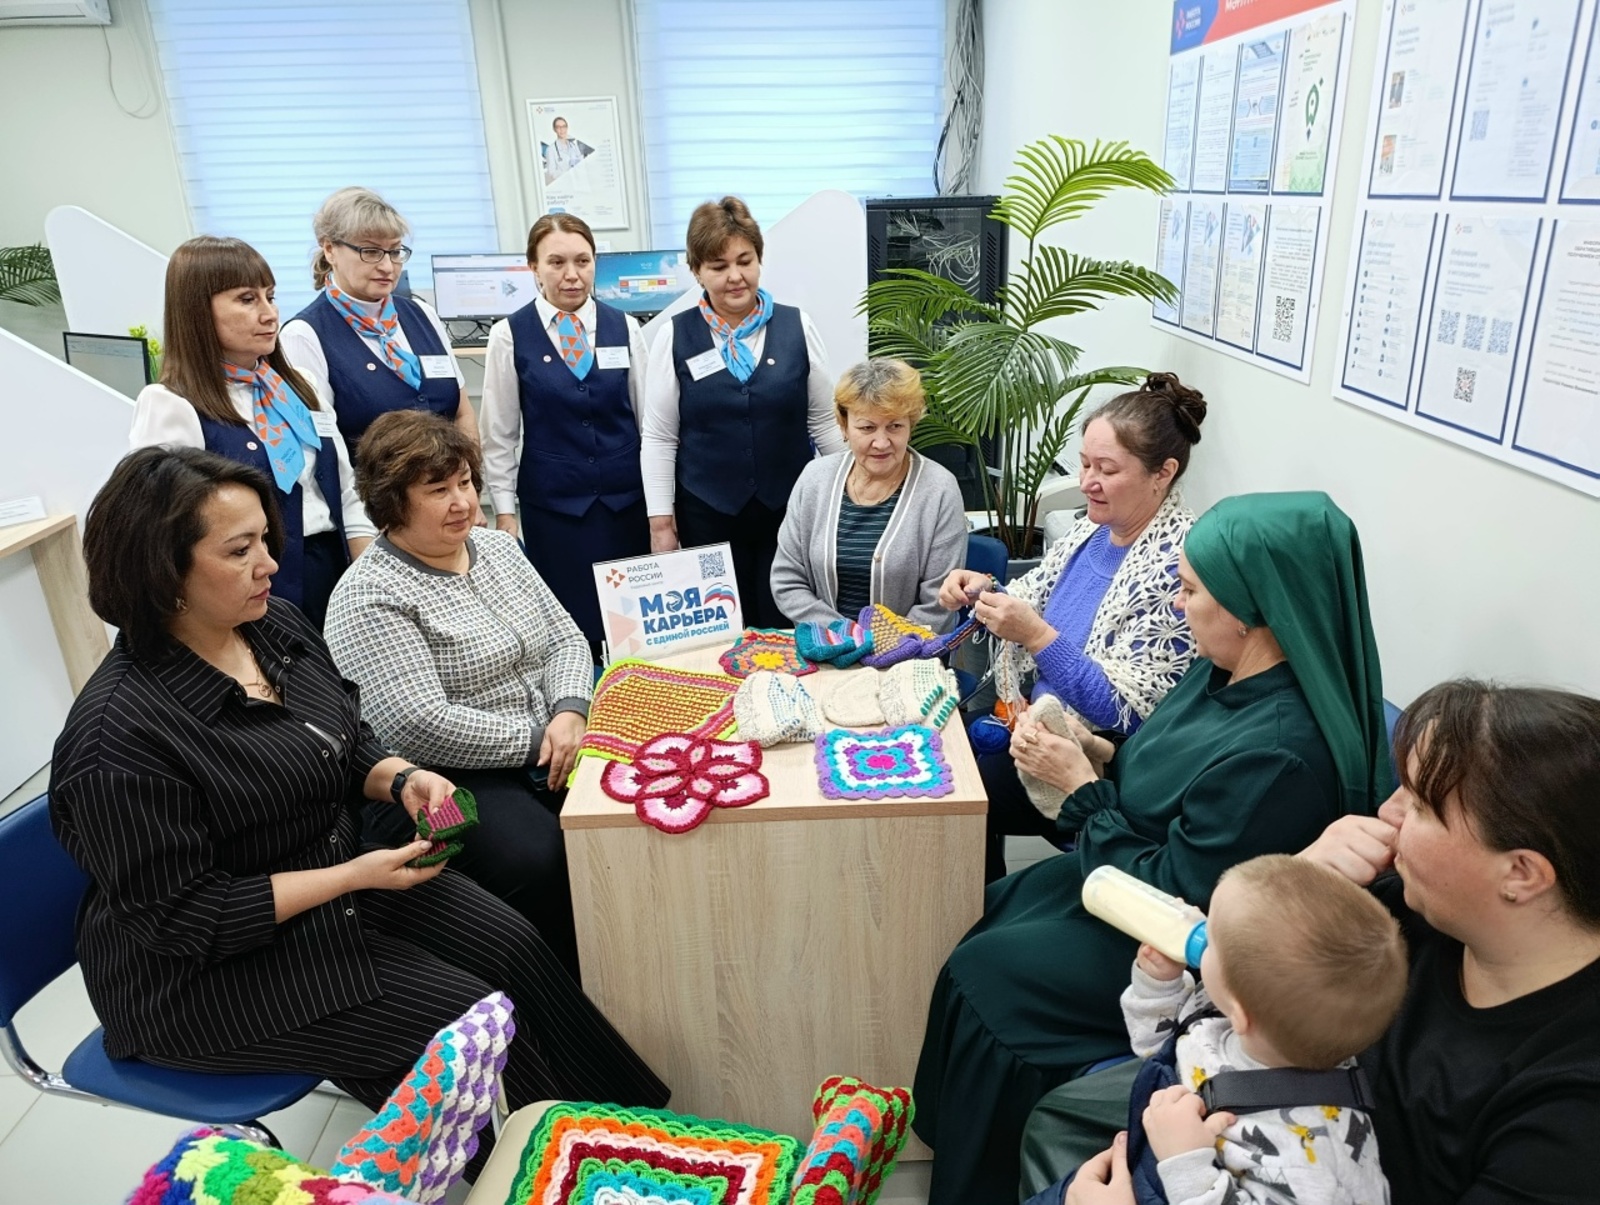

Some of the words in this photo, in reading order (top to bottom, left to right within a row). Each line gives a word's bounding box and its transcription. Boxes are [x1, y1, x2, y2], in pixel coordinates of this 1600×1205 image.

[626, 562, 659, 573] РАБОТА
[628, 572, 663, 583] РОССИИ
[638, 587, 702, 618] МОЯ
[643, 605, 728, 635] КАРЬЕРА
[646, 638, 653, 646] С
[653, 629, 690, 644] ЕДИНОЙ
[691, 621, 729, 636] РОССИЕЙ
